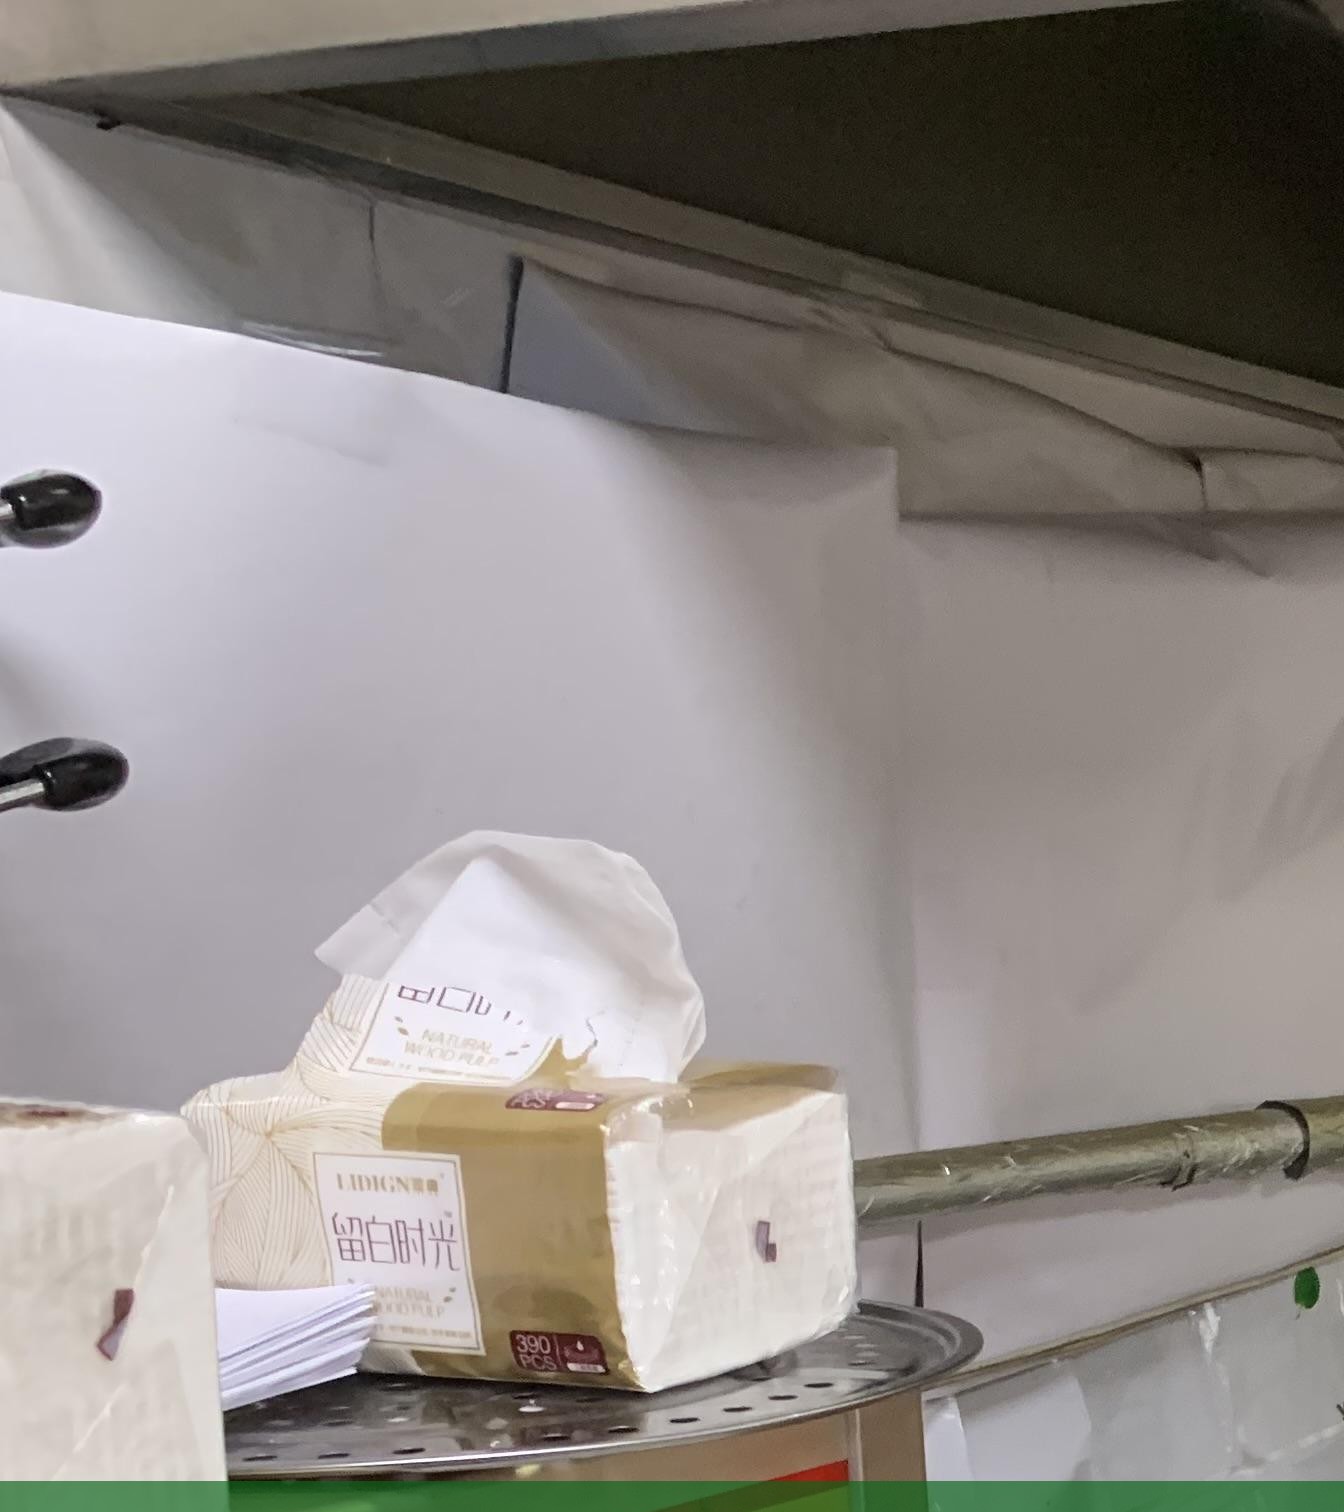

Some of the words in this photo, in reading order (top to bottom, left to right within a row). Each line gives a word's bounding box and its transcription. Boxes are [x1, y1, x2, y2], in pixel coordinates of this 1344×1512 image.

[332, 1211, 461, 1272] 留白时光
[516, 1333, 551, 1355] 390
[519, 1354, 558, 1372] PCS
